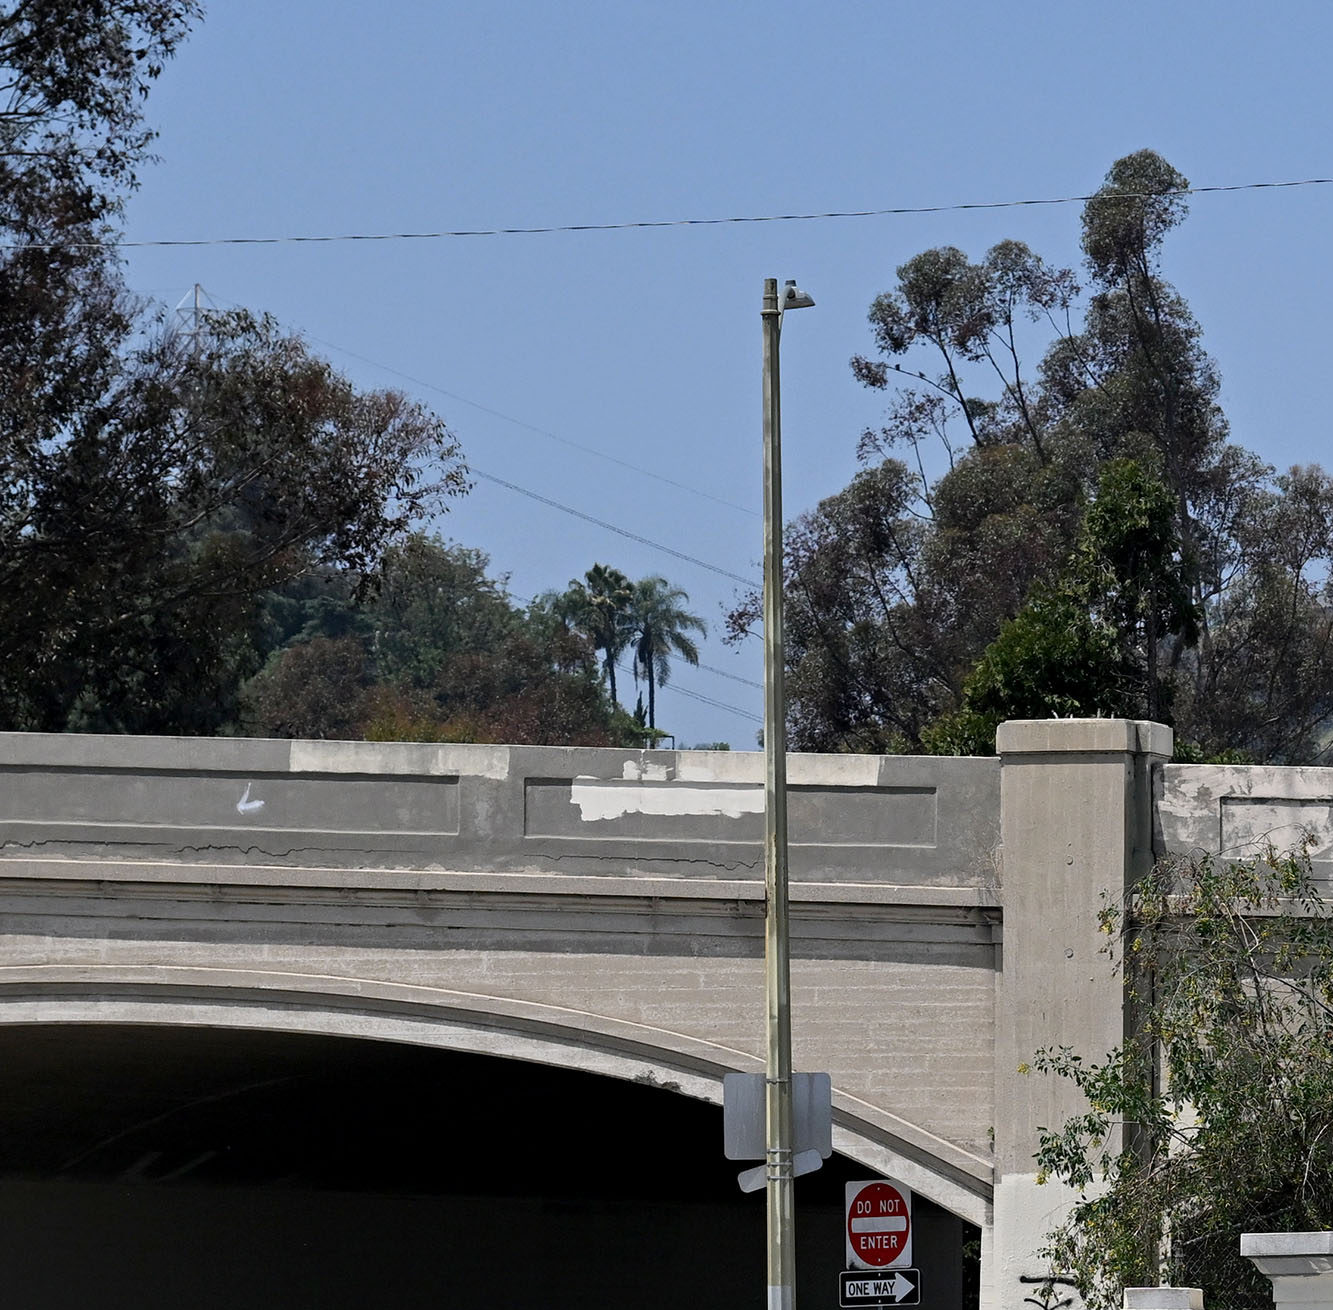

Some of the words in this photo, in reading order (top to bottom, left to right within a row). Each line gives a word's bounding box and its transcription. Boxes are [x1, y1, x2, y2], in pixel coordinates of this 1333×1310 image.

[857, 1200, 871, 1214] DO
[880, 1199, 900, 1213] NOT
[860, 1235, 898, 1250] ENTER
[848, 1282, 869, 1296] ONE
[873, 1281, 896, 1295] WAY
